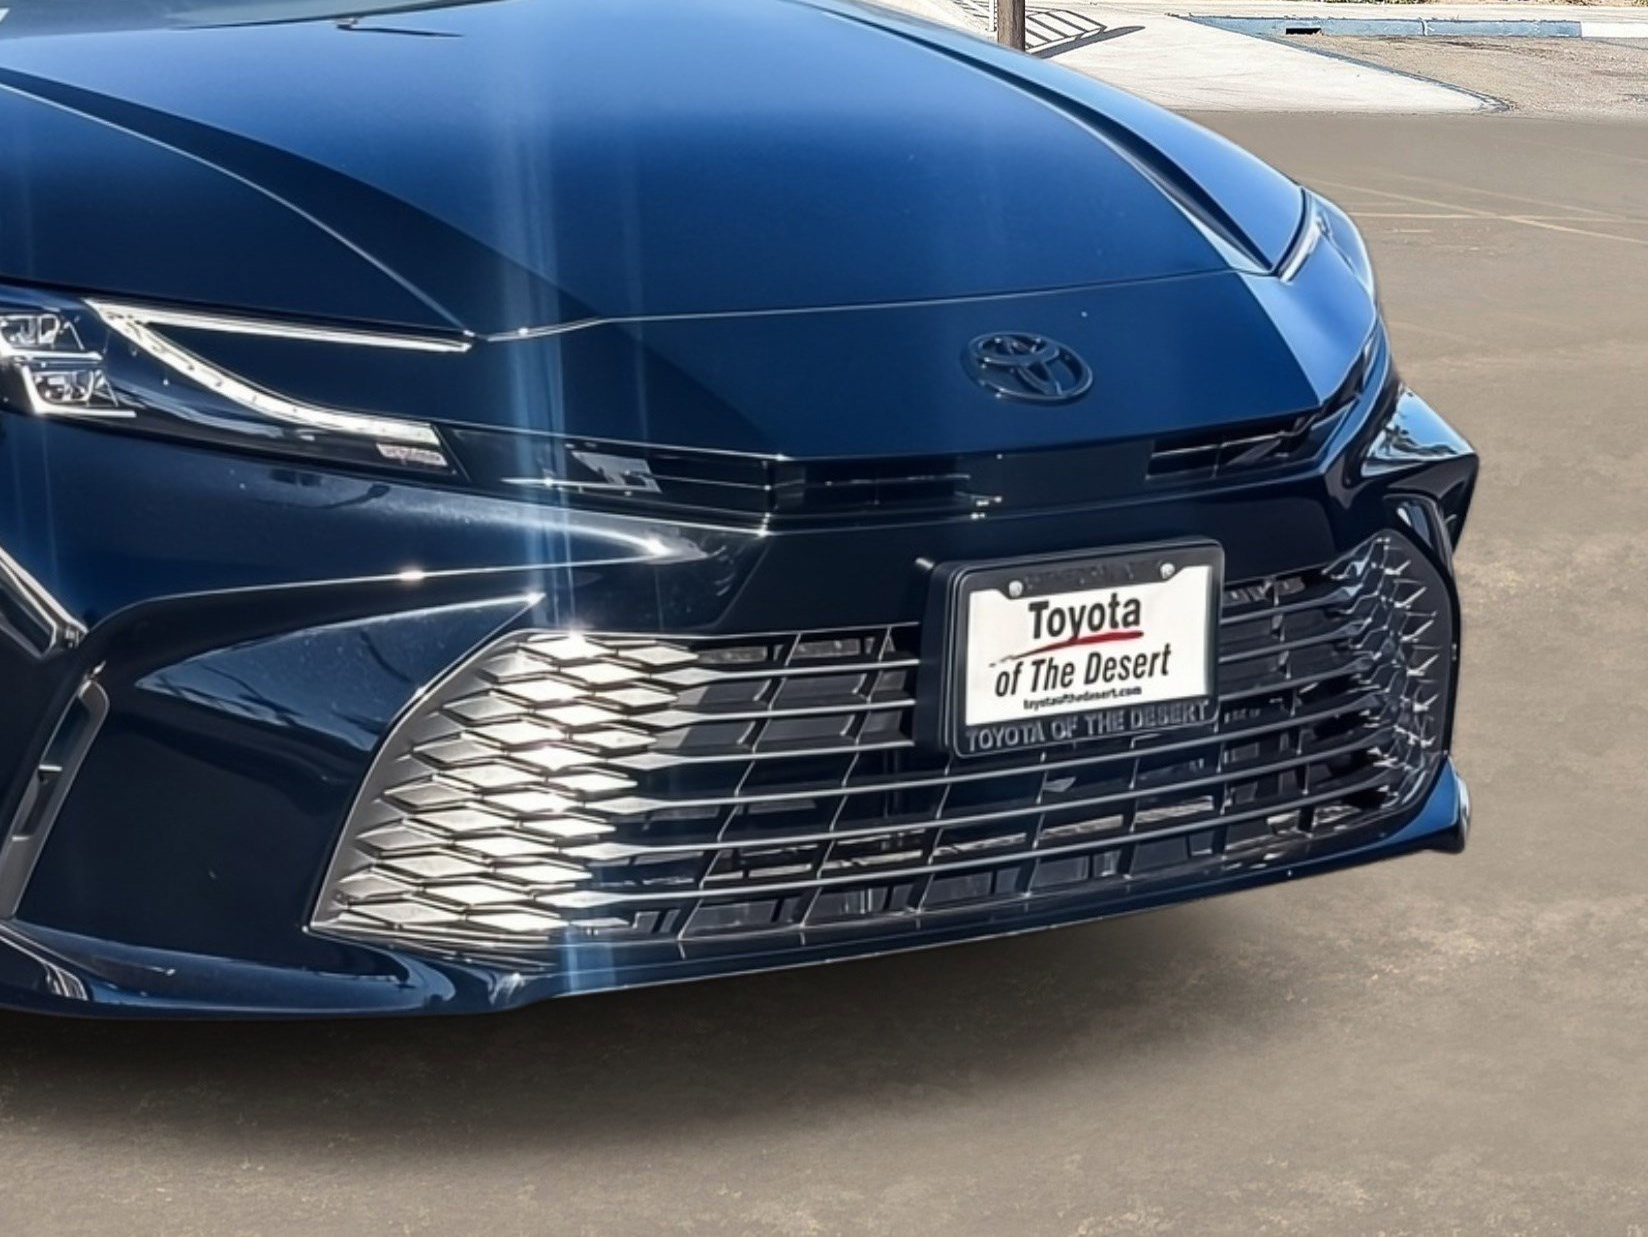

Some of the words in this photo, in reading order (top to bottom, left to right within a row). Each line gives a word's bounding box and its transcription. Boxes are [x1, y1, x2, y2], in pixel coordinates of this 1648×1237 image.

[1028, 593, 1141, 640] Toyota
[995, 660, 1023, 698] of
[1030, 657, 1074, 692] The
[1084, 643, 1172, 684] Desert
[967, 723, 1045, 752] TOYOTA
[1051, 715, 1079, 740] OF
[1085, 709, 1125, 735] THE
[1130, 700, 1209, 729] DESERT
